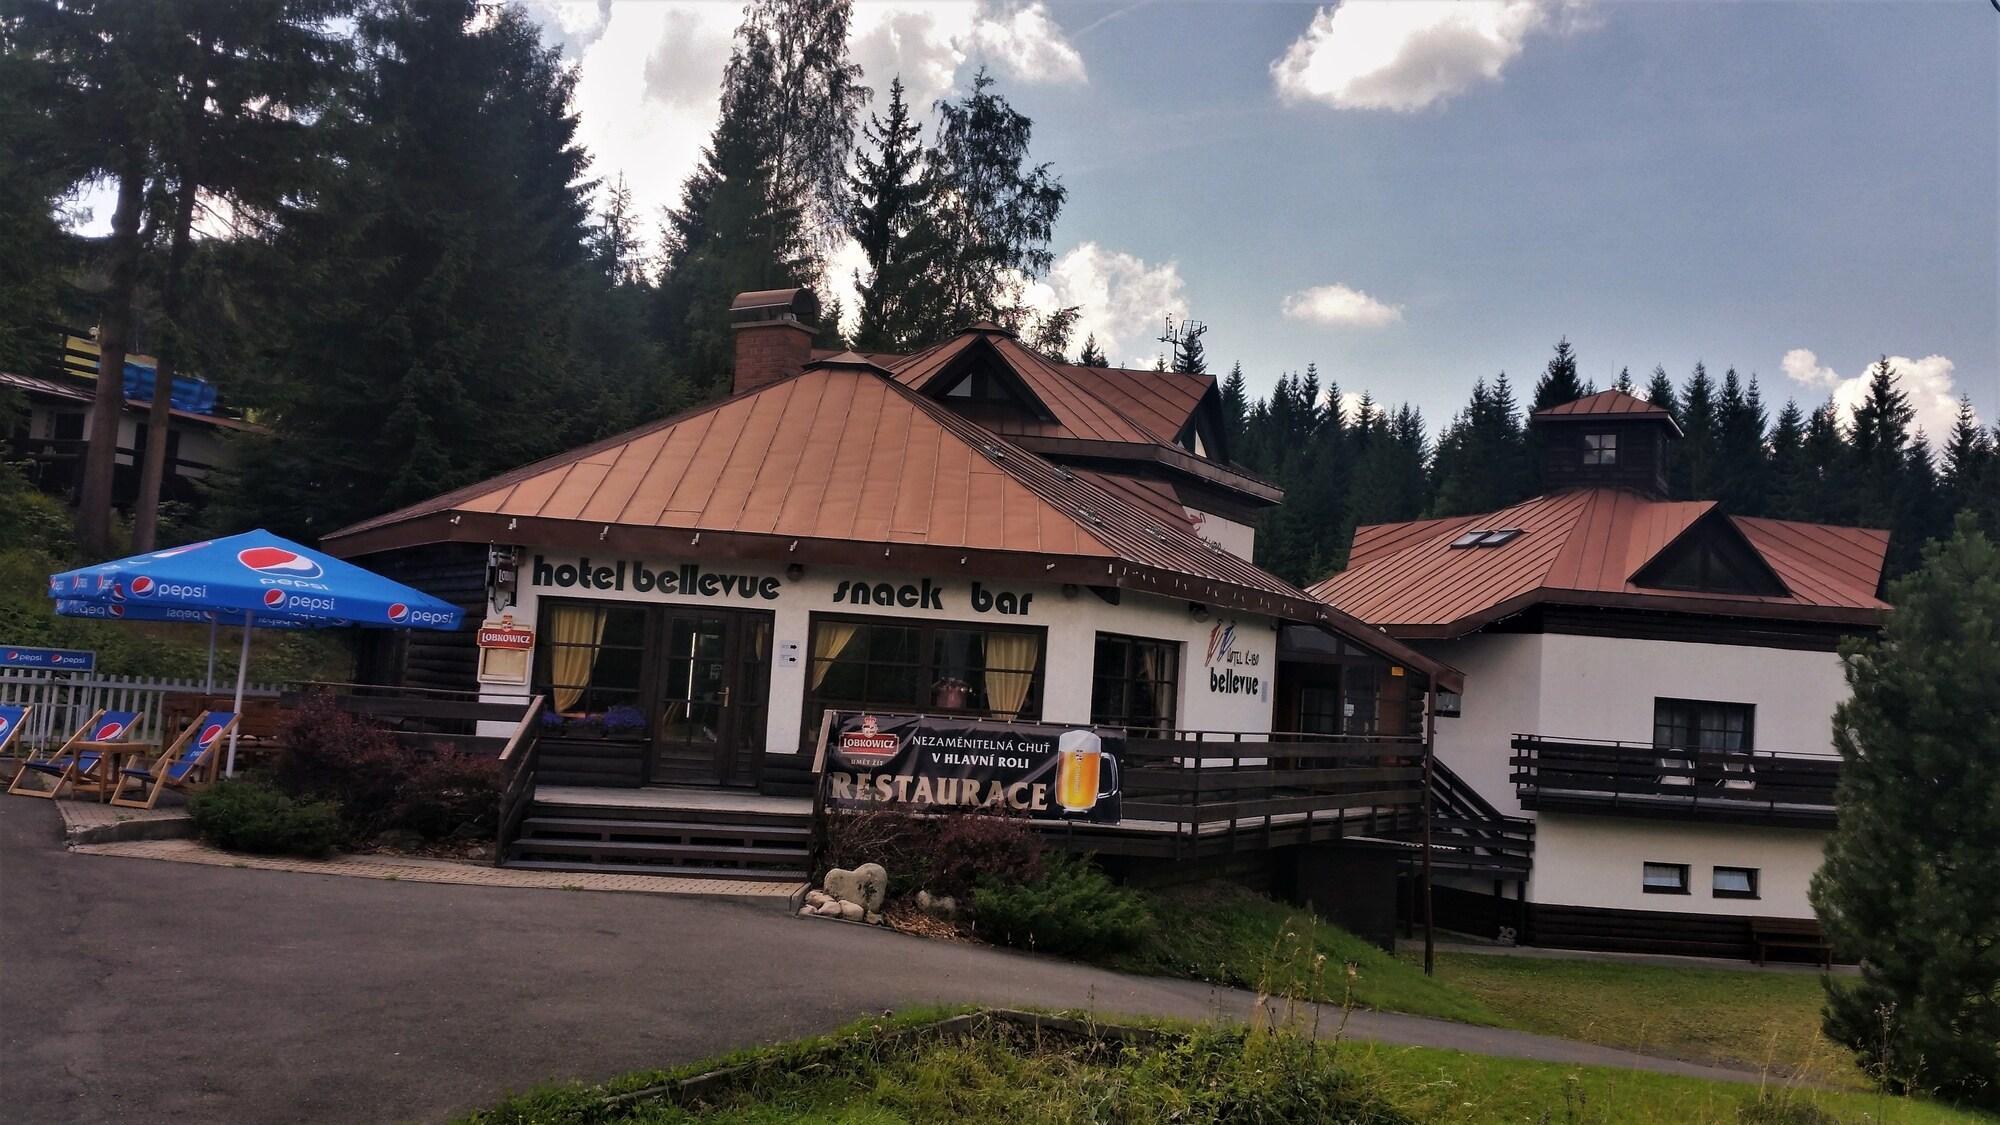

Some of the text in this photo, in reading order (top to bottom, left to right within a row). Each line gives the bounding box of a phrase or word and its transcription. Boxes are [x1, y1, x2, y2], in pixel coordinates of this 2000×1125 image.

[259, 577, 329, 591] pepsi
[532, 554, 782, 600] hotel bellevue
[158, 584, 207, 599] pepsi
[833, 578, 1033, 615] snack bar
[288, 595, 335, 611] pepsi
[411, 609, 455, 625] pepsi
[481, 632, 531, 643] LOBKOWICZ
[19, 653, 42, 662] pepsi
[63, 656, 86, 664] pepsi
[1210, 666, 1259, 696] bellevue
[843, 737, 895, 749] LOBKOWICZ
[912, 735, 1051, 754] NEZAMĚNITELNÁ CHUŤ
[931, 752, 1030, 769] V HLAVNÍ ROLI
[831, 771, 1049, 811] RESTAURACE
